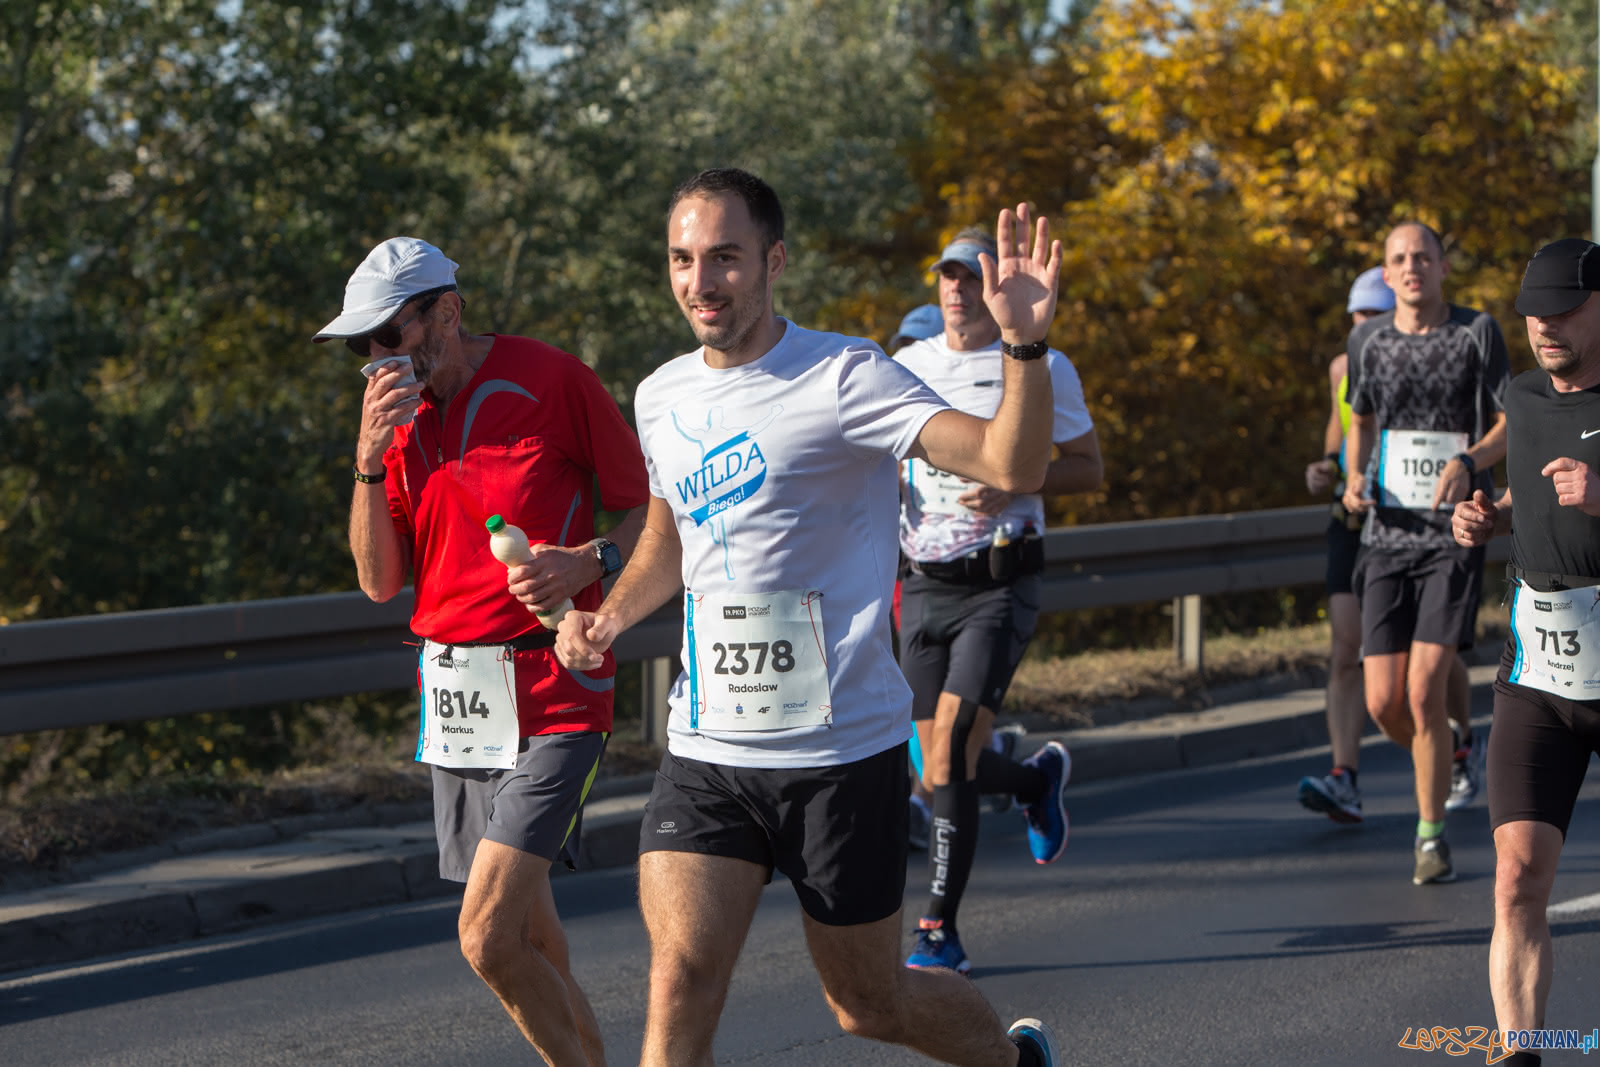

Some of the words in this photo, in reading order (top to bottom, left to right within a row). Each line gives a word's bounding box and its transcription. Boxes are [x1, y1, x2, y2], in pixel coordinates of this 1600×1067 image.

[675, 441, 766, 505] WILDA
[707, 486, 746, 516] Biega!
[724, 608, 745, 617] 19.PKO
[1535, 626, 1582, 657] 713
[712, 639, 796, 676] 2378
[432, 687, 490, 719] 1814
[728, 682, 778, 694] Radoslaw
[441, 725, 475, 735] Markus
